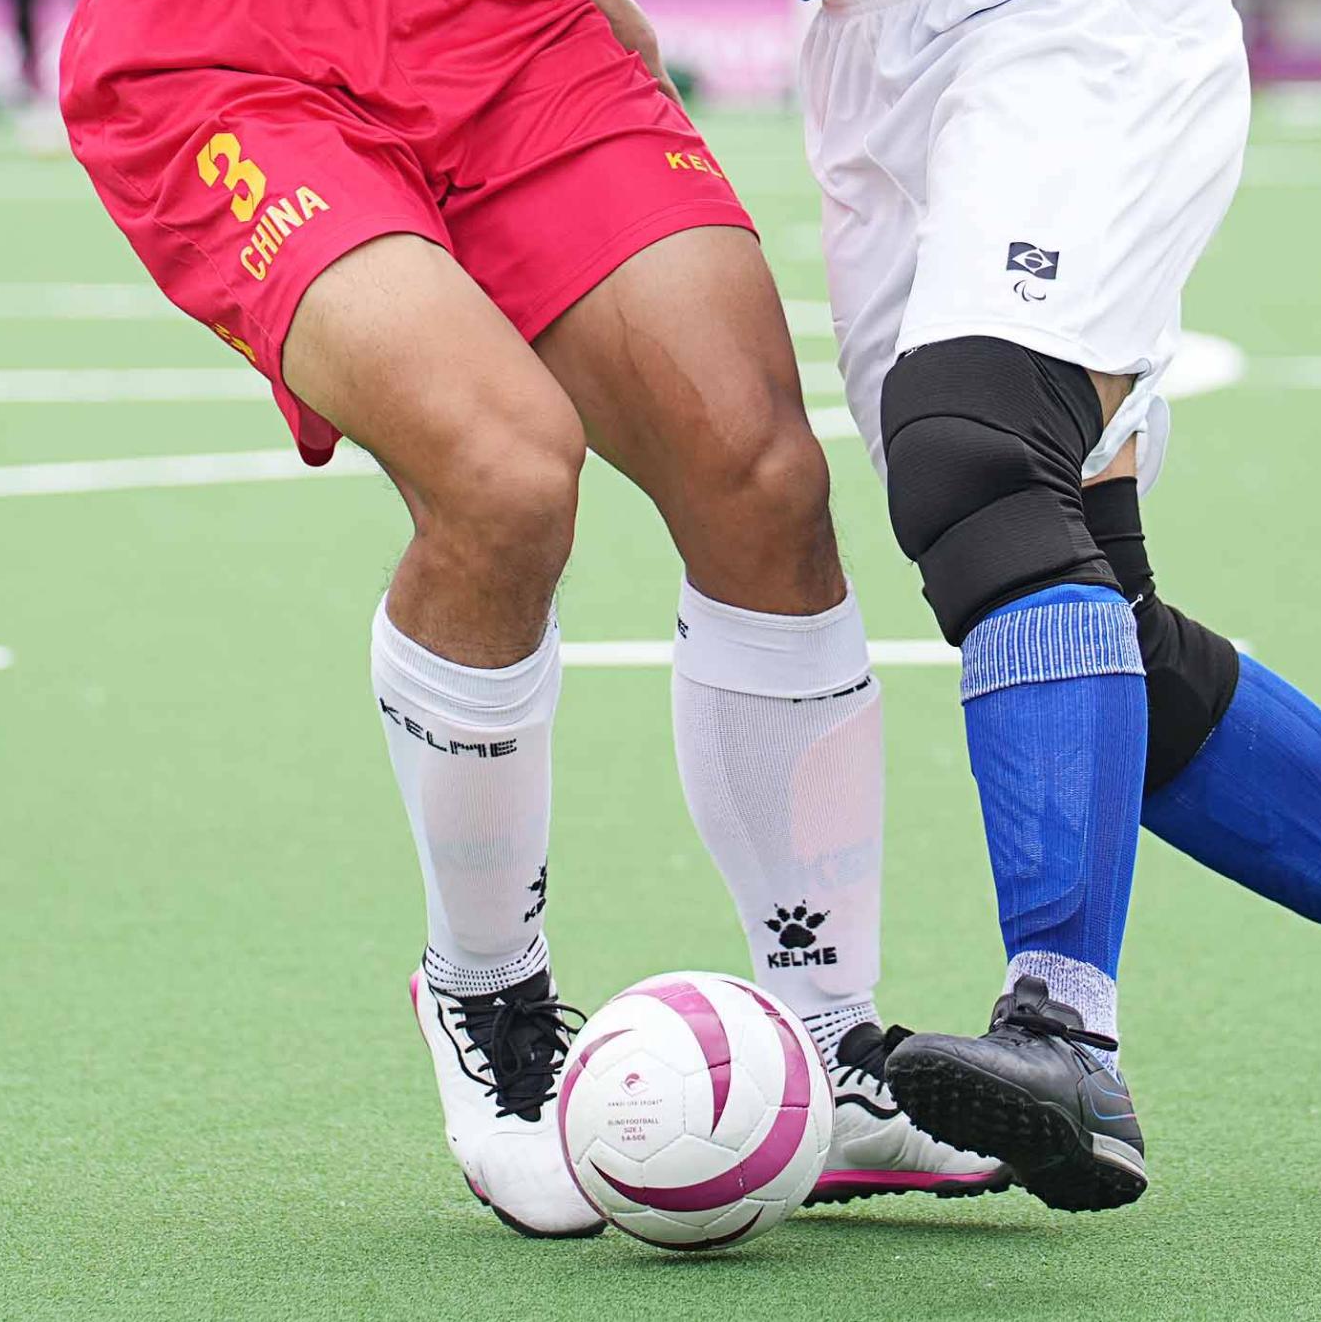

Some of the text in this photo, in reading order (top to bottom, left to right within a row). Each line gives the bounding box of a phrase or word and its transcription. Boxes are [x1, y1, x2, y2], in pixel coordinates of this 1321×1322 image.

[196, 133, 267, 223] 3
[240, 186, 331, 281] CHINA
[379, 697, 518, 758] KELME
[767, 946, 837, 969] KELME
